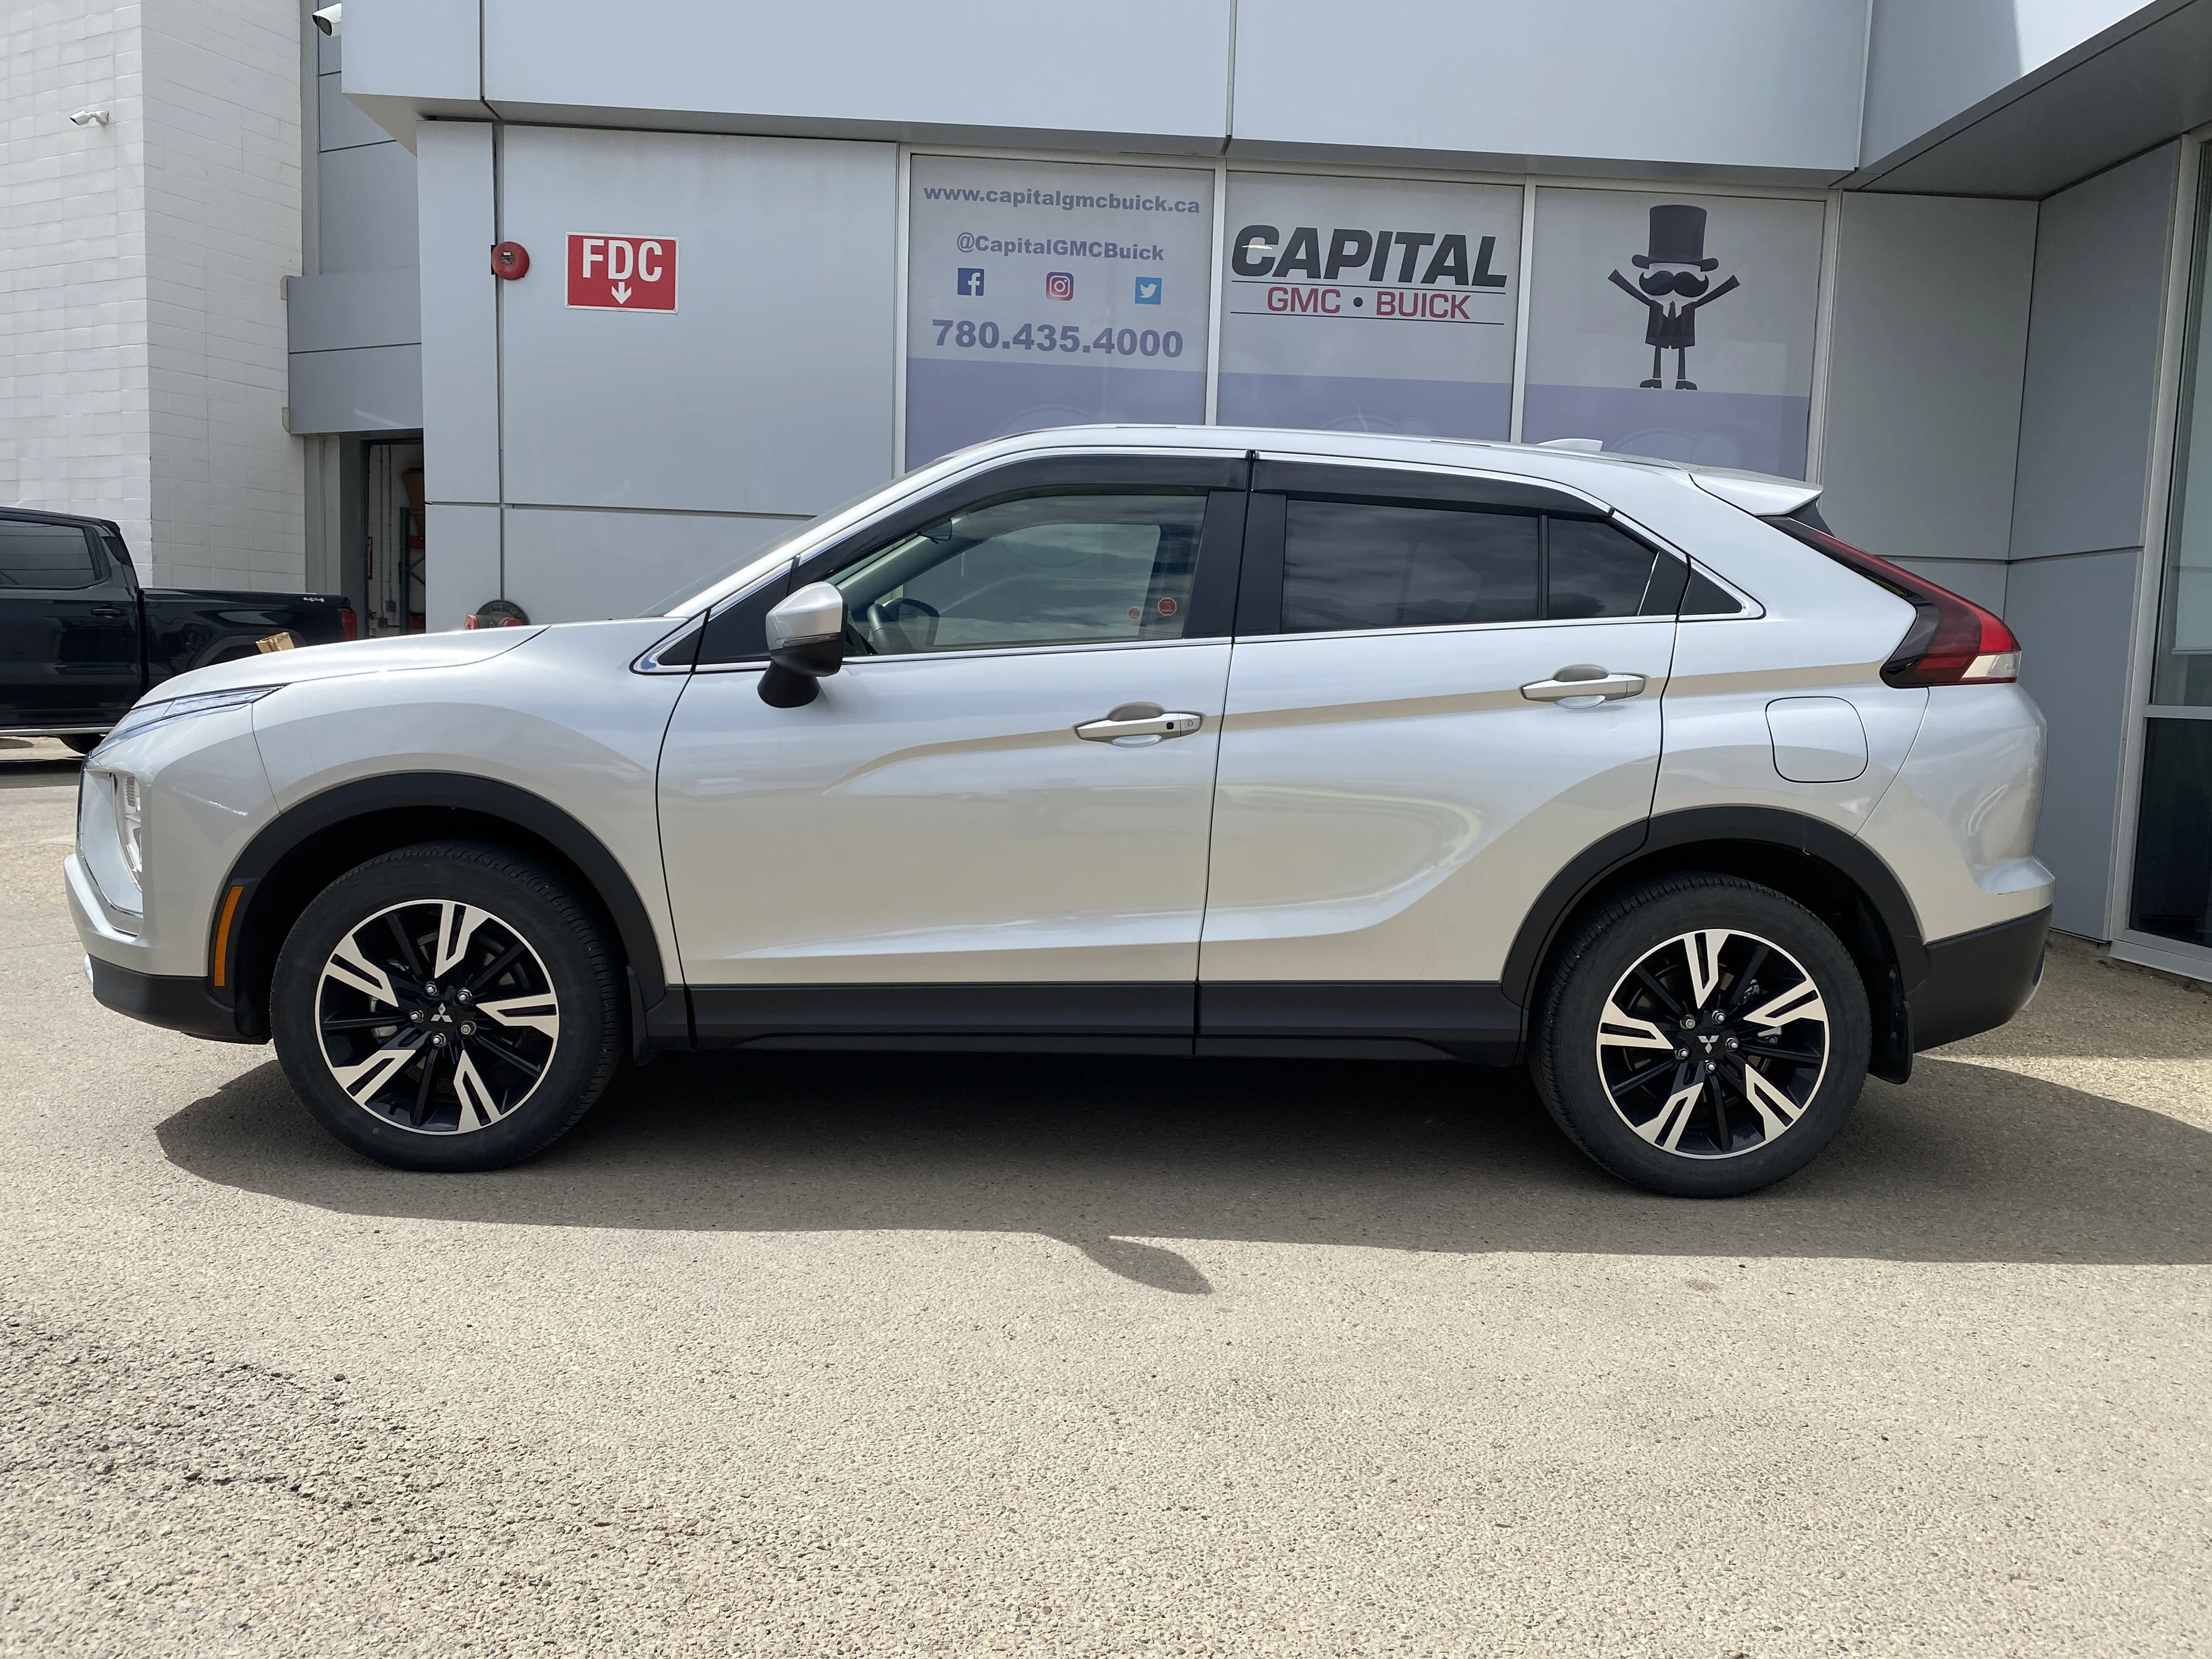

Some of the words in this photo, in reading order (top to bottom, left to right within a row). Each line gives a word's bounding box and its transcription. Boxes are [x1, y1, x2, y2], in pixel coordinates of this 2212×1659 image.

[923, 187, 1200, 213] www.capitalgmcbuick.ca
[583, 238, 663, 282] FDC
[957, 232, 1164, 261] @CapitalGMCBuick
[1232, 224, 1508, 287] CAPITAL
[1267, 286, 1341, 314] GMC
[1376, 290, 1471, 319] BUICK
[933, 319, 1183, 358] 780.435.4000
